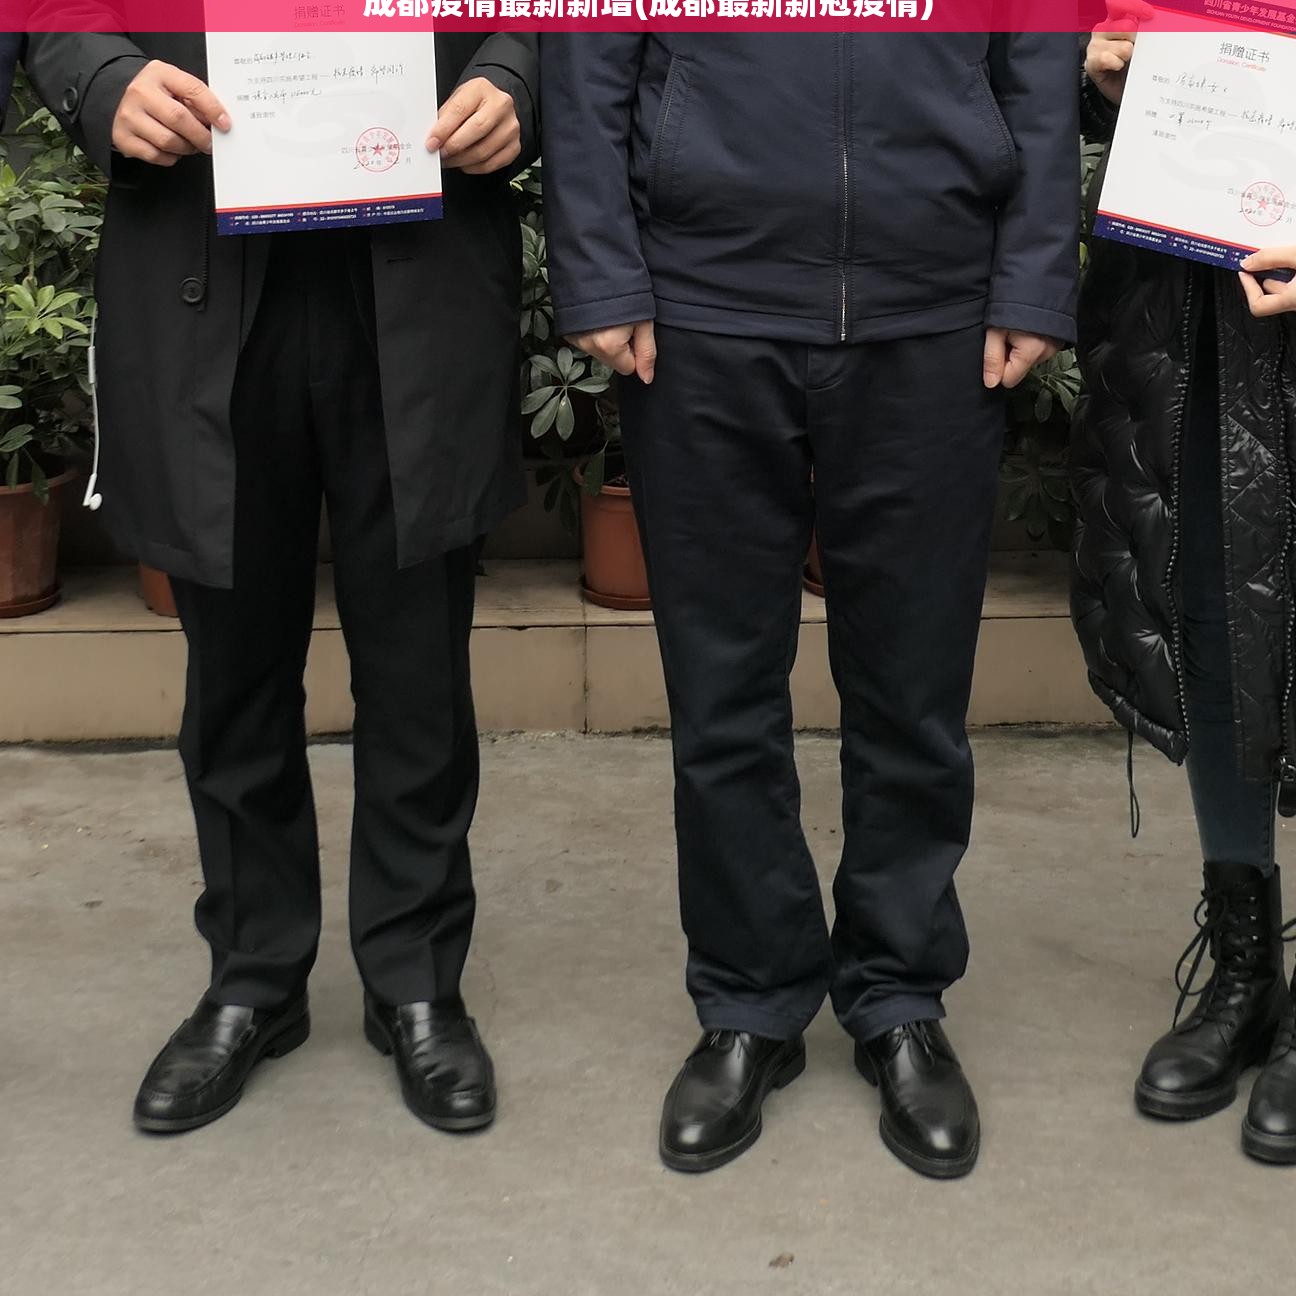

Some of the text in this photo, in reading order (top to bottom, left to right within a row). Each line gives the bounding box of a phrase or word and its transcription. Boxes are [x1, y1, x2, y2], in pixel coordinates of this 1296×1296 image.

[294, 4, 346, 20] 捐赠证书
[1219, 41, 1271, 64] 捐赠证书
